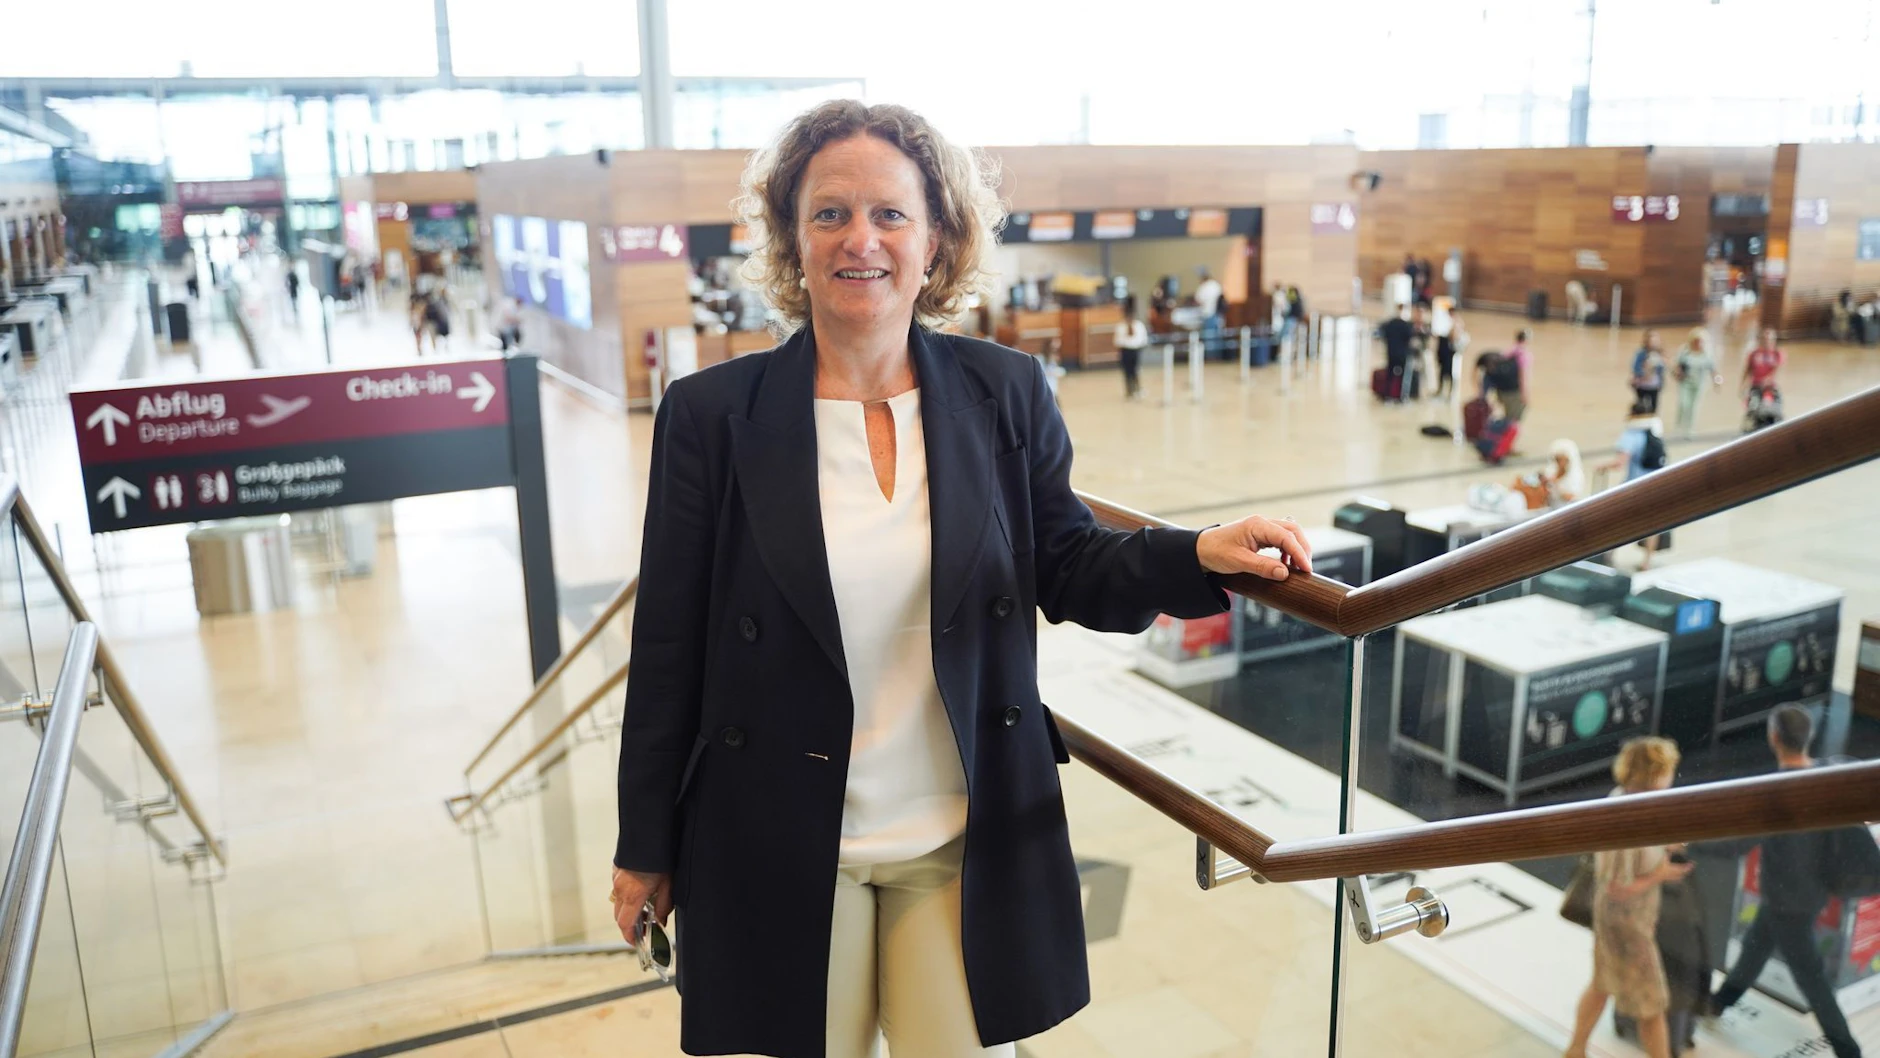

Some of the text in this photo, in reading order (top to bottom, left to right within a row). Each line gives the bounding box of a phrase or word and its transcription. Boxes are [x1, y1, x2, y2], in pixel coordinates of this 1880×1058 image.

[346, 370, 452, 402] Check-in
[136, 391, 226, 420] Abflug
[138, 417, 240, 445] Departure
[235, 456, 345, 485] Großgepäck
[238, 479, 343, 503] Bulky Baggage
